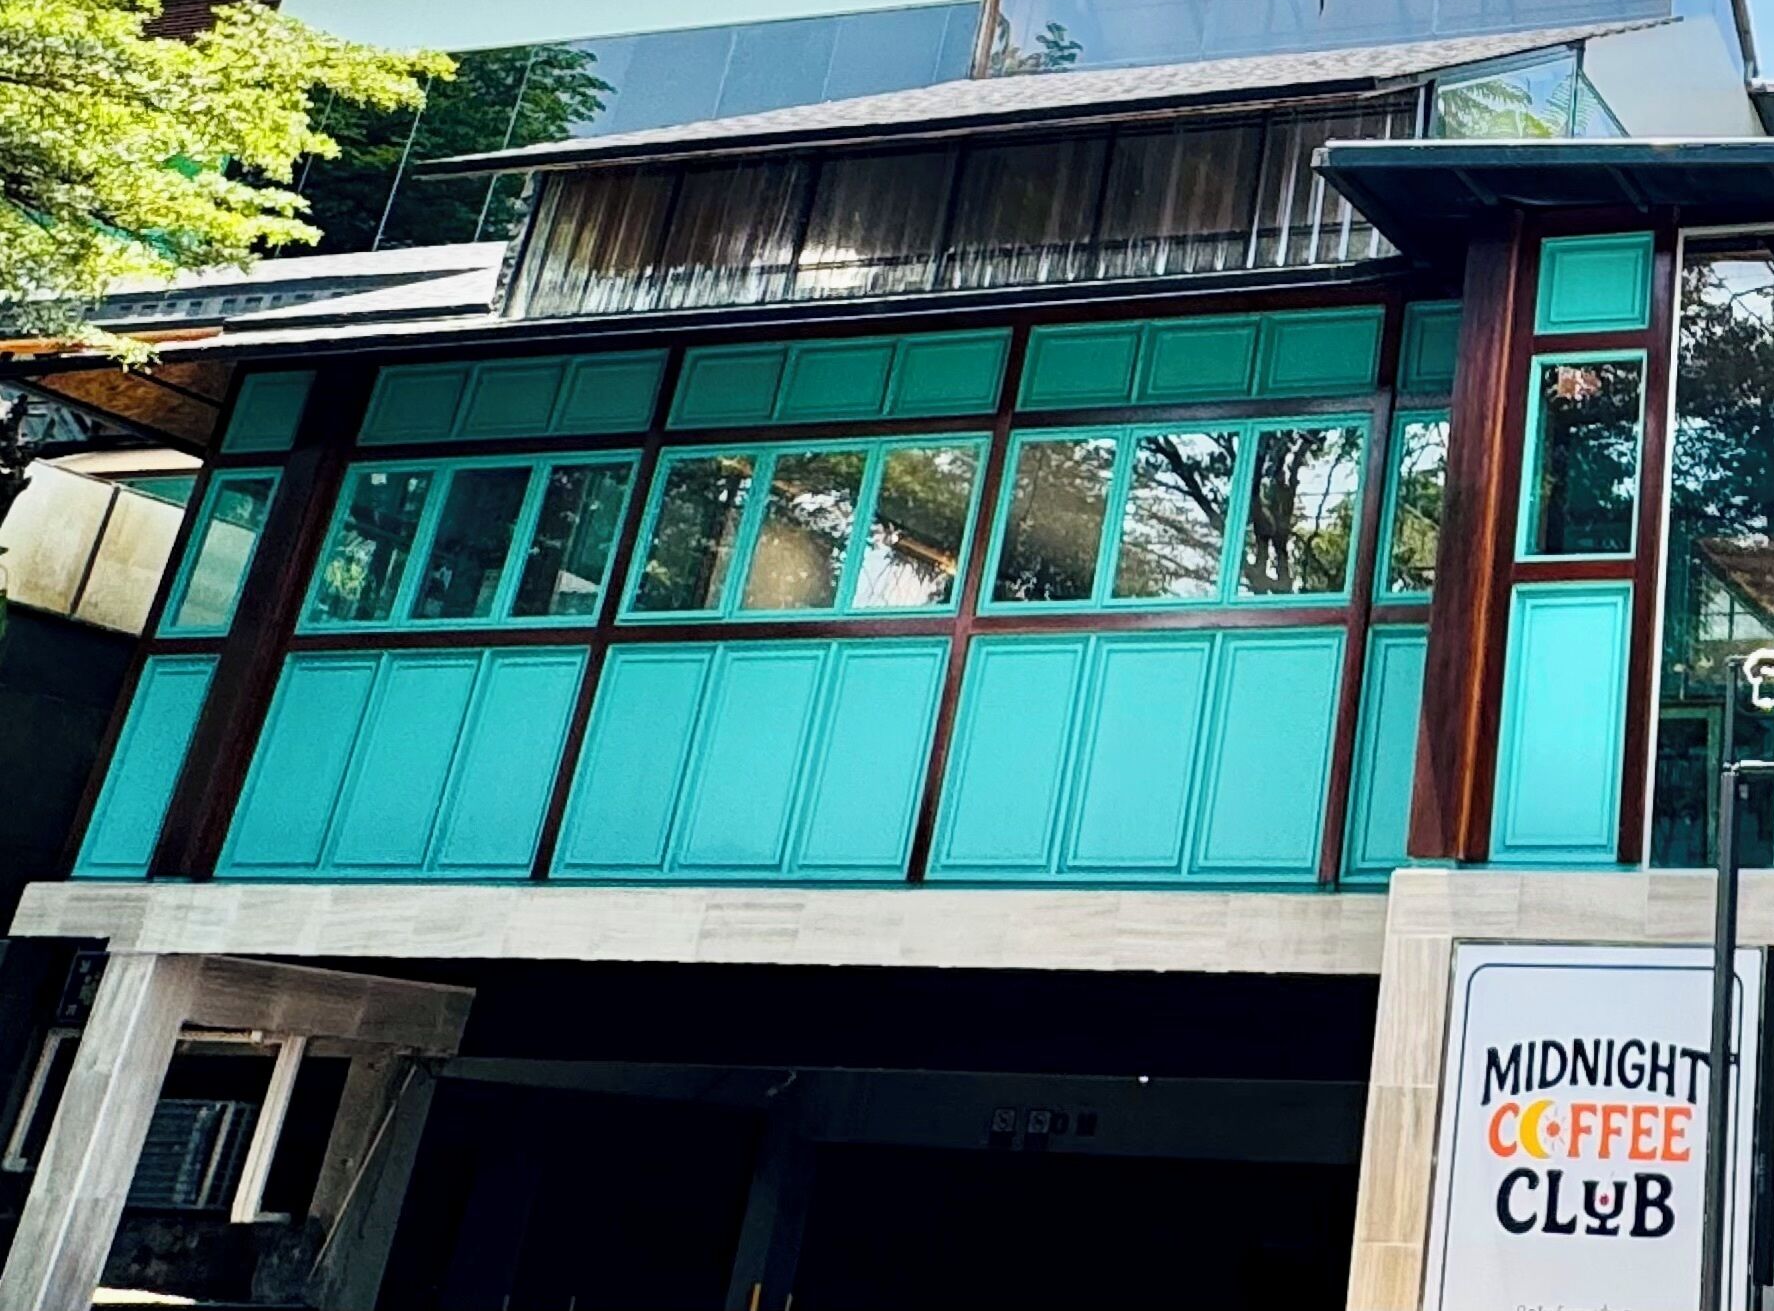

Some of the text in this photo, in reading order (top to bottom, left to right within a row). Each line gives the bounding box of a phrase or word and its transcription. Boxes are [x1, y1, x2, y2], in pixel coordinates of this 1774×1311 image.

[1480, 1037, 1712, 1106] MIDNIGHT
[1488, 1098, 1694, 1162] COFFEE
[1496, 1166, 1676, 1238] CLUB
